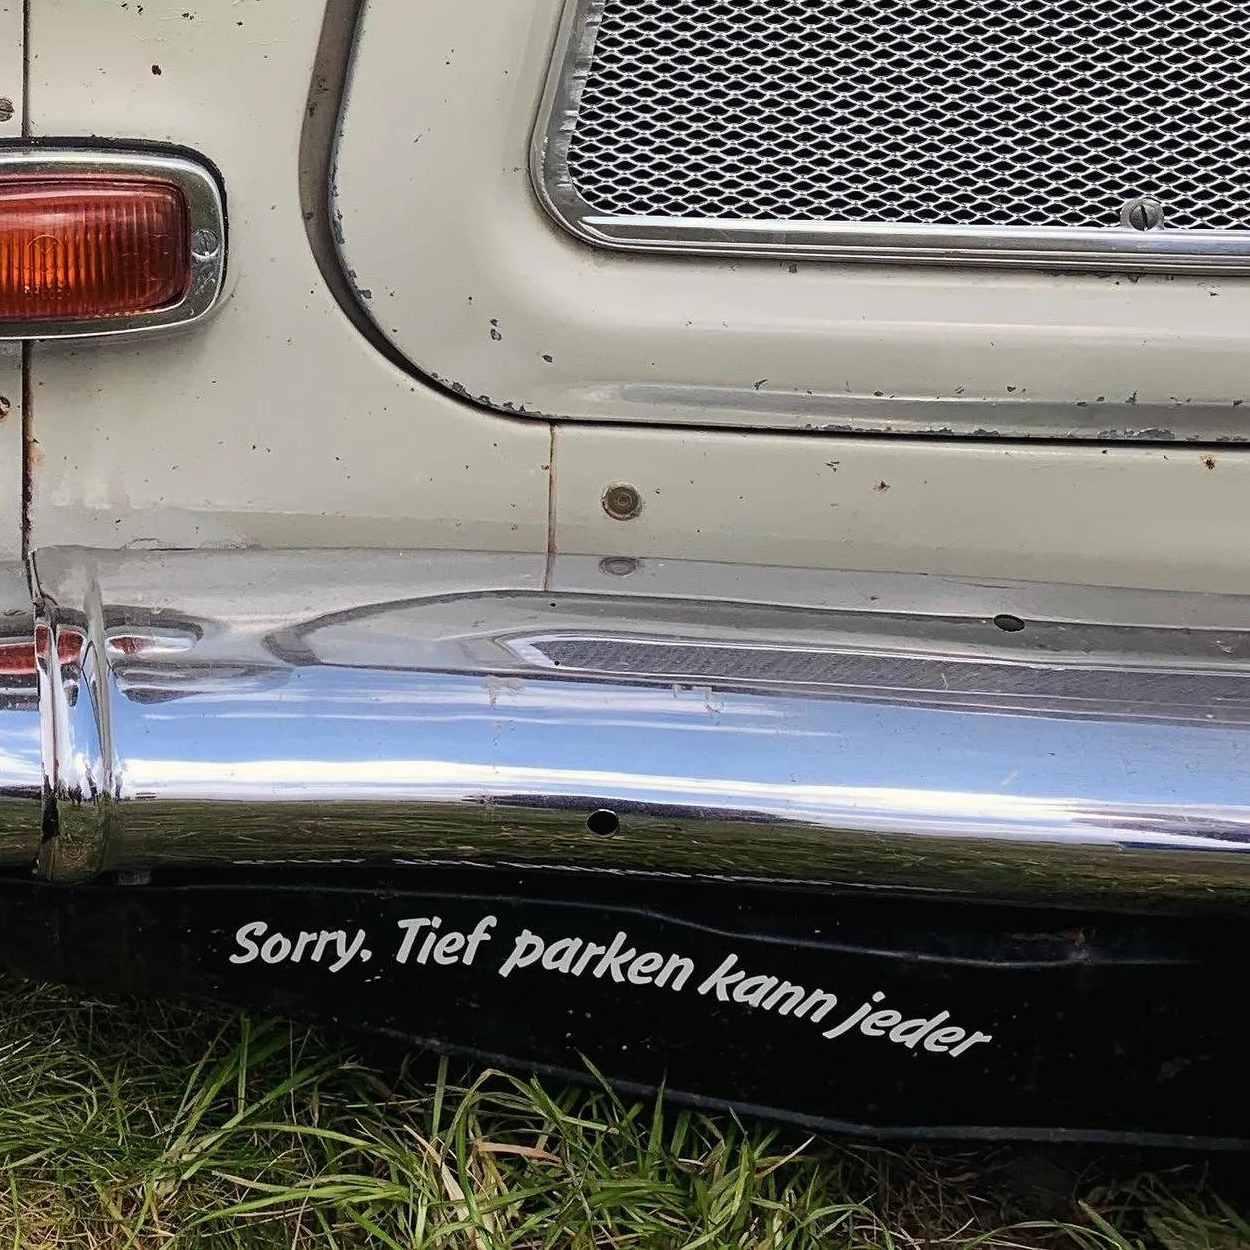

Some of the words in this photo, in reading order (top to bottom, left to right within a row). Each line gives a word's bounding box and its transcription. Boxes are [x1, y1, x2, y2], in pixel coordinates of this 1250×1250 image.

[396, 916, 498, 965] Tief
[499, 929, 695, 991] parken
[698, 954, 838, 1022] kann
[823, 992, 992, 1057] jeder
